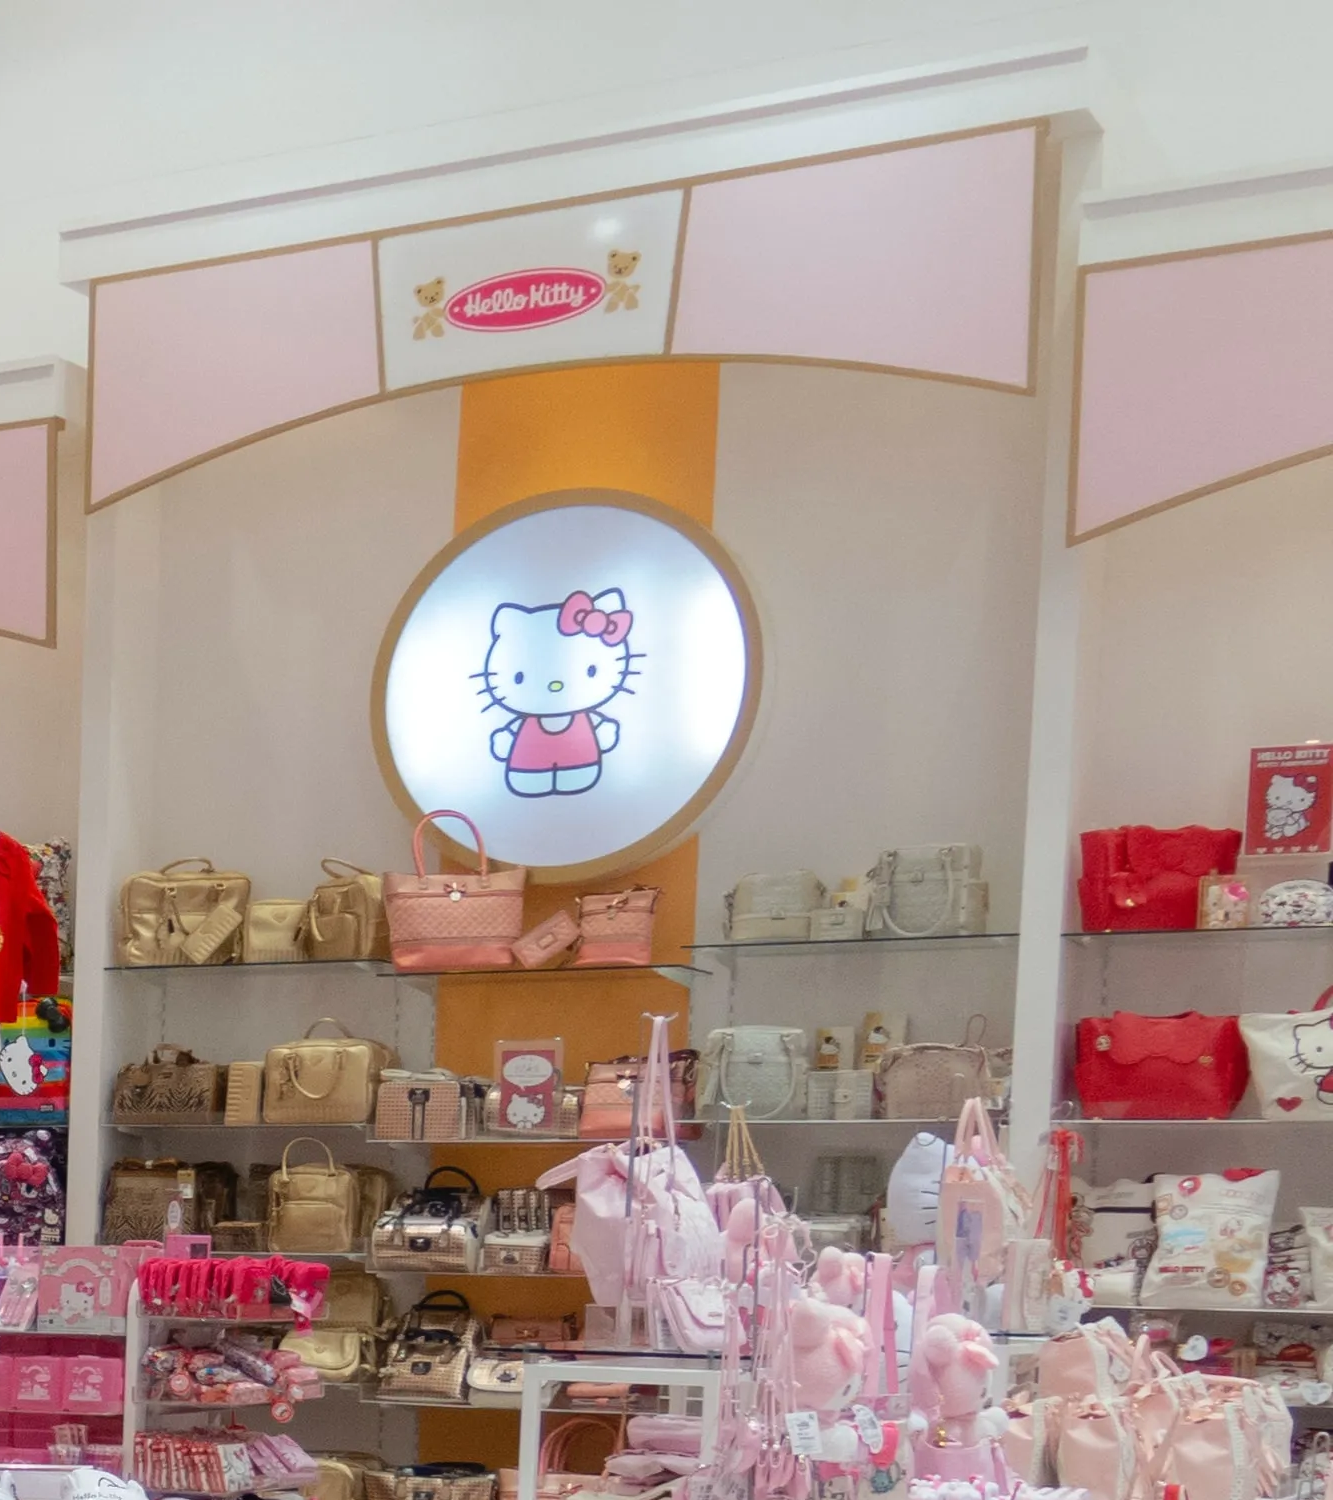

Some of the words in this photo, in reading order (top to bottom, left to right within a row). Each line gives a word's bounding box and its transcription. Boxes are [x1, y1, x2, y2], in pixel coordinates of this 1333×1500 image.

[464, 287, 529, 317] Hello
[530, 281, 587, 309] Kitty
[1257, 751, 1293, 761] HELLO
